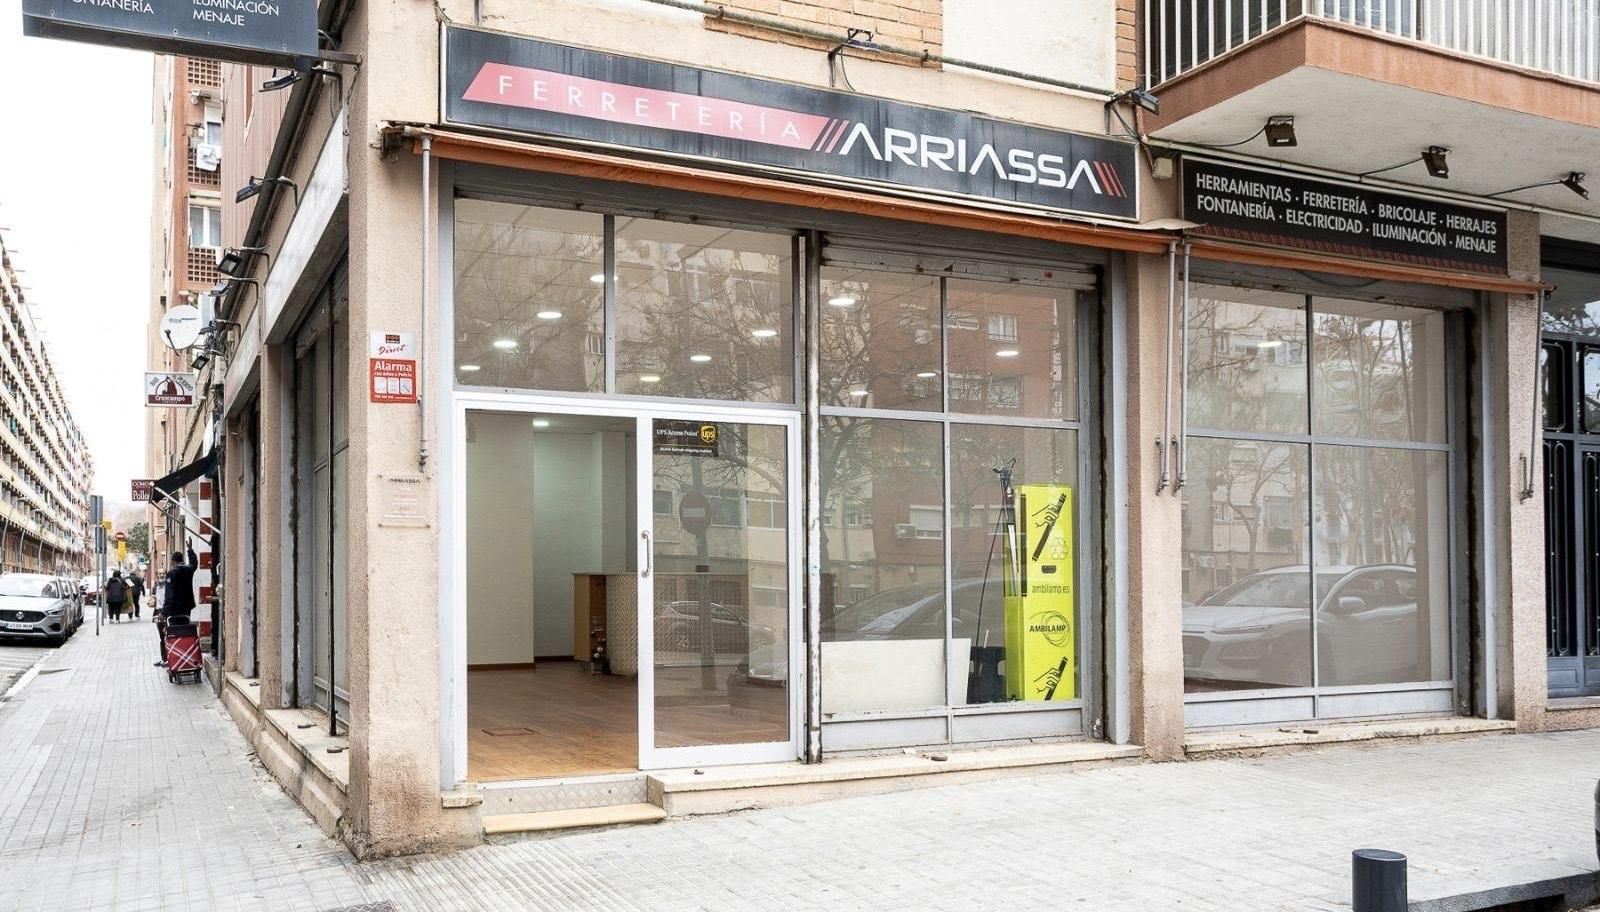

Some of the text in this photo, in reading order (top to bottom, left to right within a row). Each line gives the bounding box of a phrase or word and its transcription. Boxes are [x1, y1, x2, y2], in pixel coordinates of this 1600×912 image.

[72, 0, 154, 14] TANERÍA
[192, 9, 245, 26] MENAJE
[499, 75, 1102, 195] FERRETERÍA ARRIASSA
[1196, 172, 1497, 235] HERRAMIENTAS FERRETERÍA BRICOLAJE HERRAJES
[1197, 194, 1496, 254] FONTANERÍA ELECTRICIDAD ILUMINACIÓN MENAJE
[374, 360, 413, 372] Alarma
[1029, 624, 1067, 633] AMBILAMP
